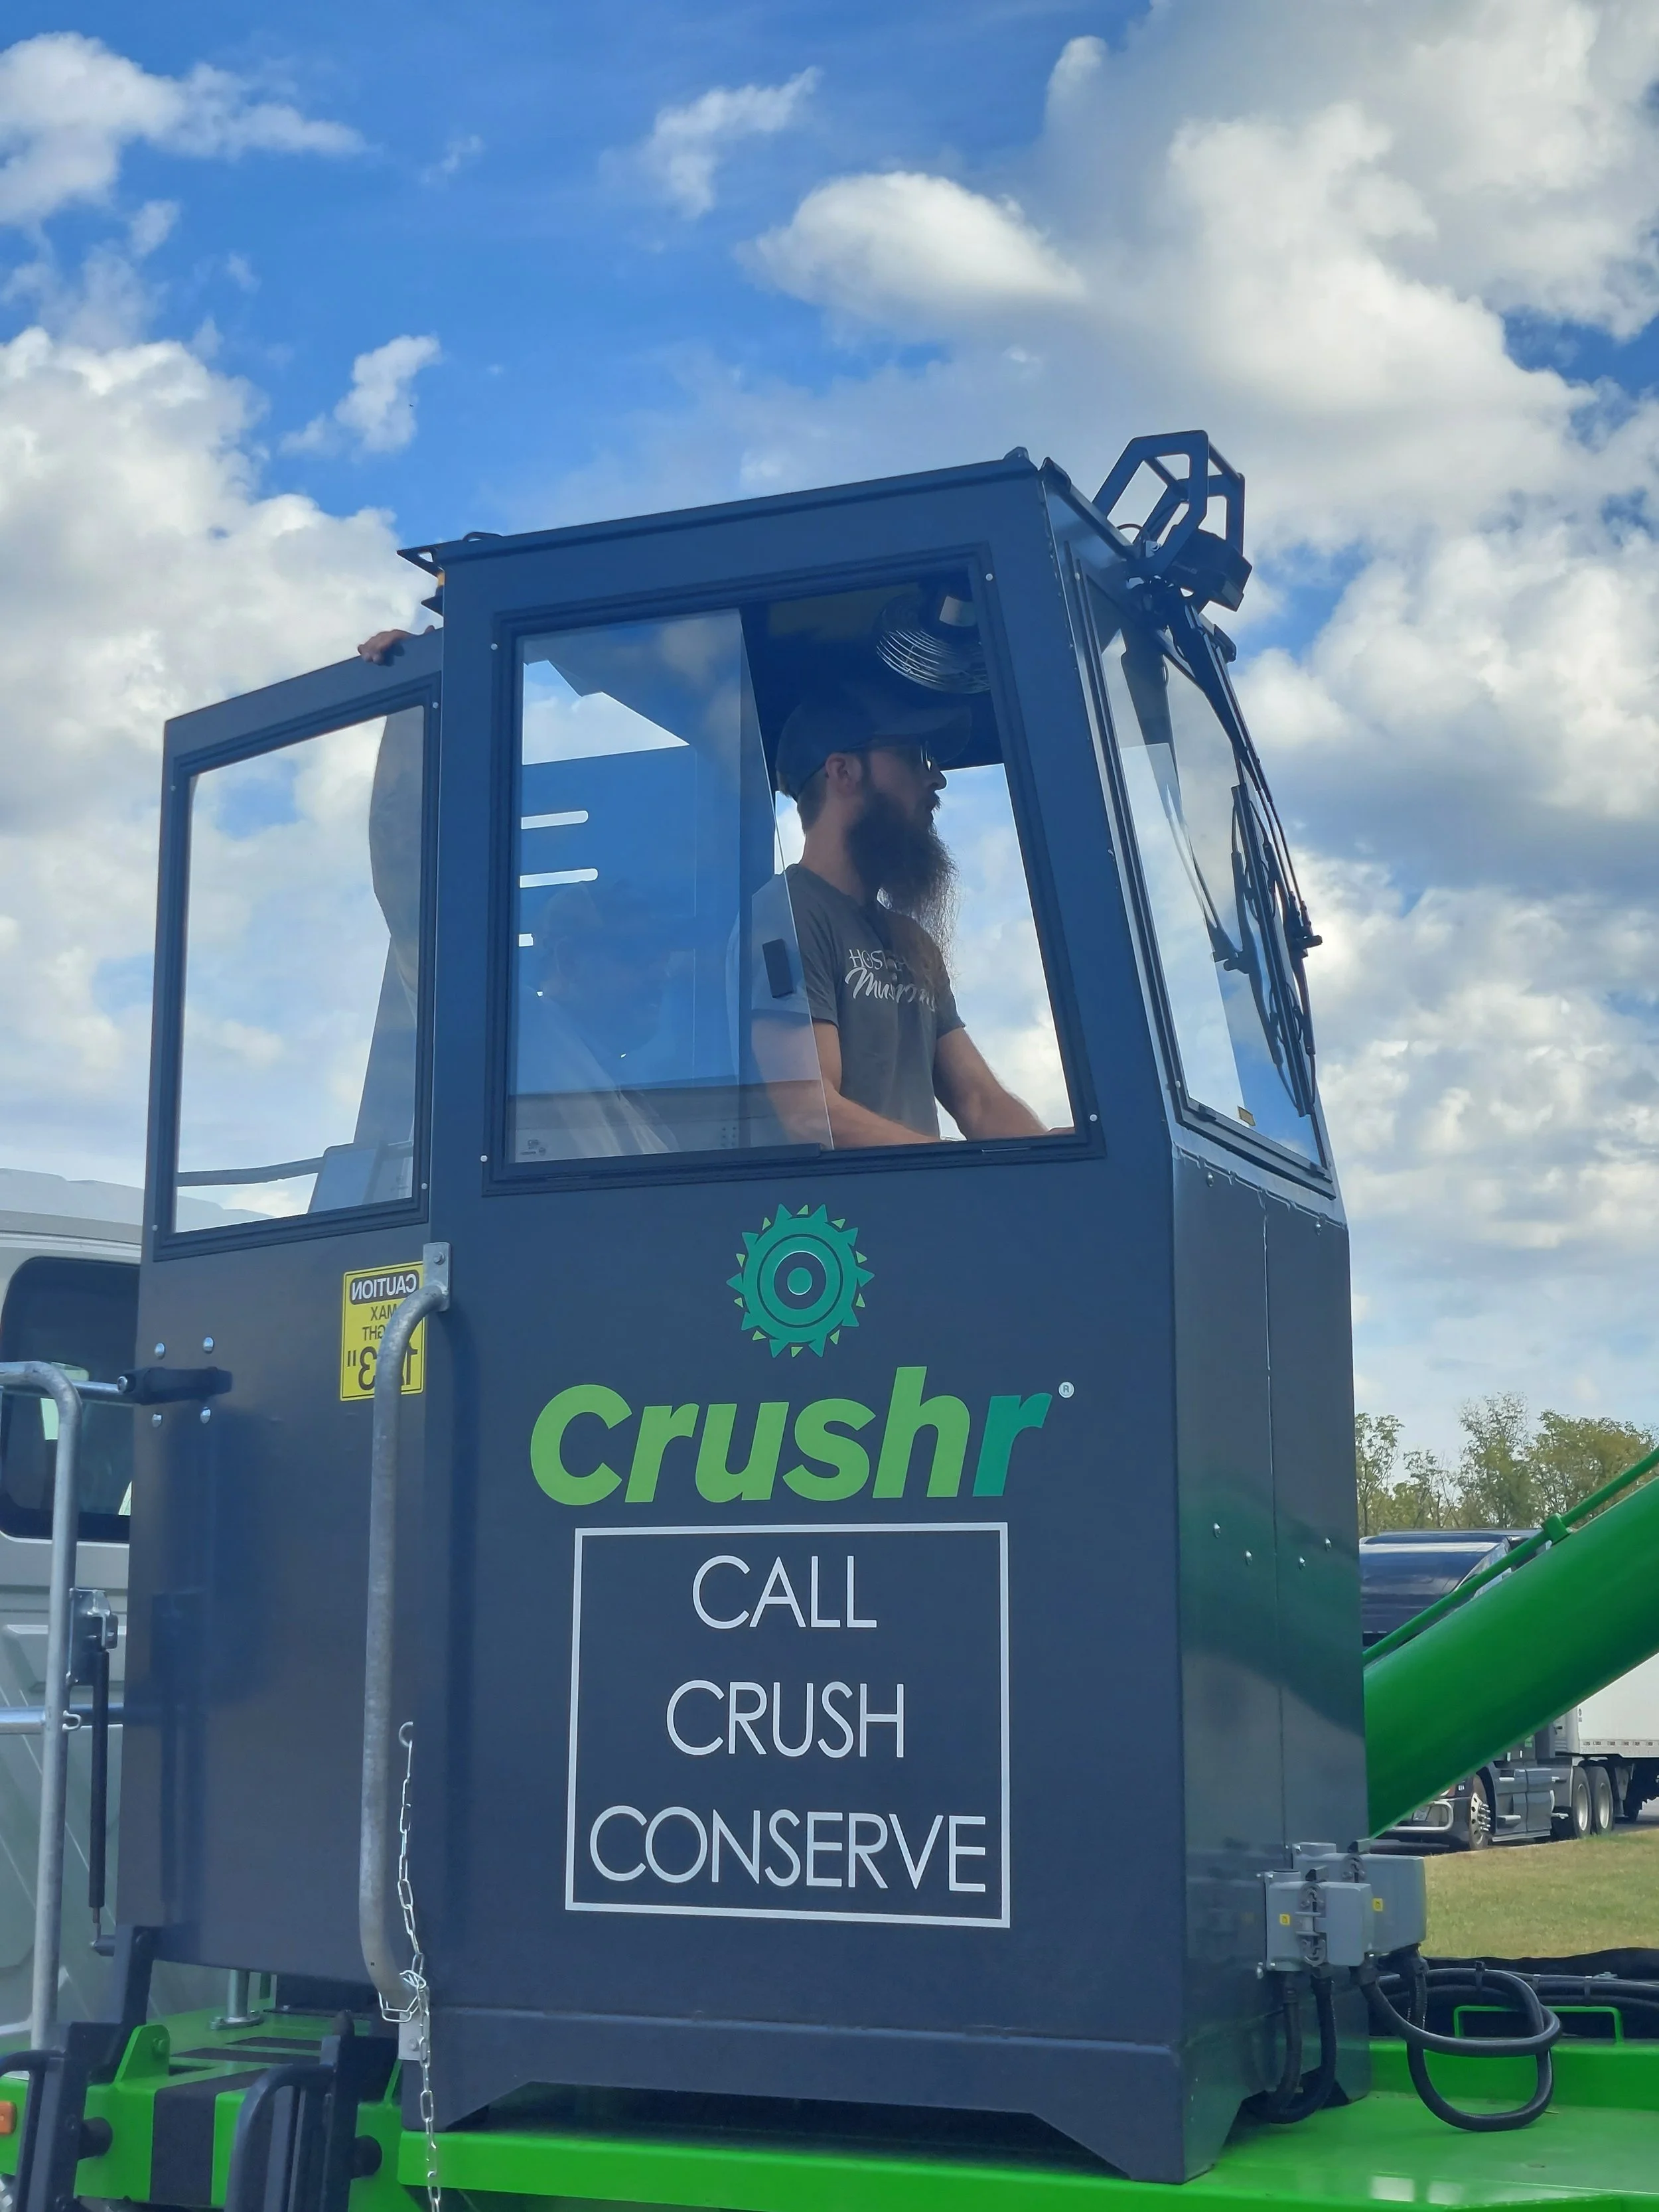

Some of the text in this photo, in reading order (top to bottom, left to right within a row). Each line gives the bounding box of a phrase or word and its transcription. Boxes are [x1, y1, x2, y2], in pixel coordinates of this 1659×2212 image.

[693, 1555, 877, 1629] CALL
[667, 1680, 904, 1758] CRUSH
[590, 1805, 986, 1892] CONSERVE
